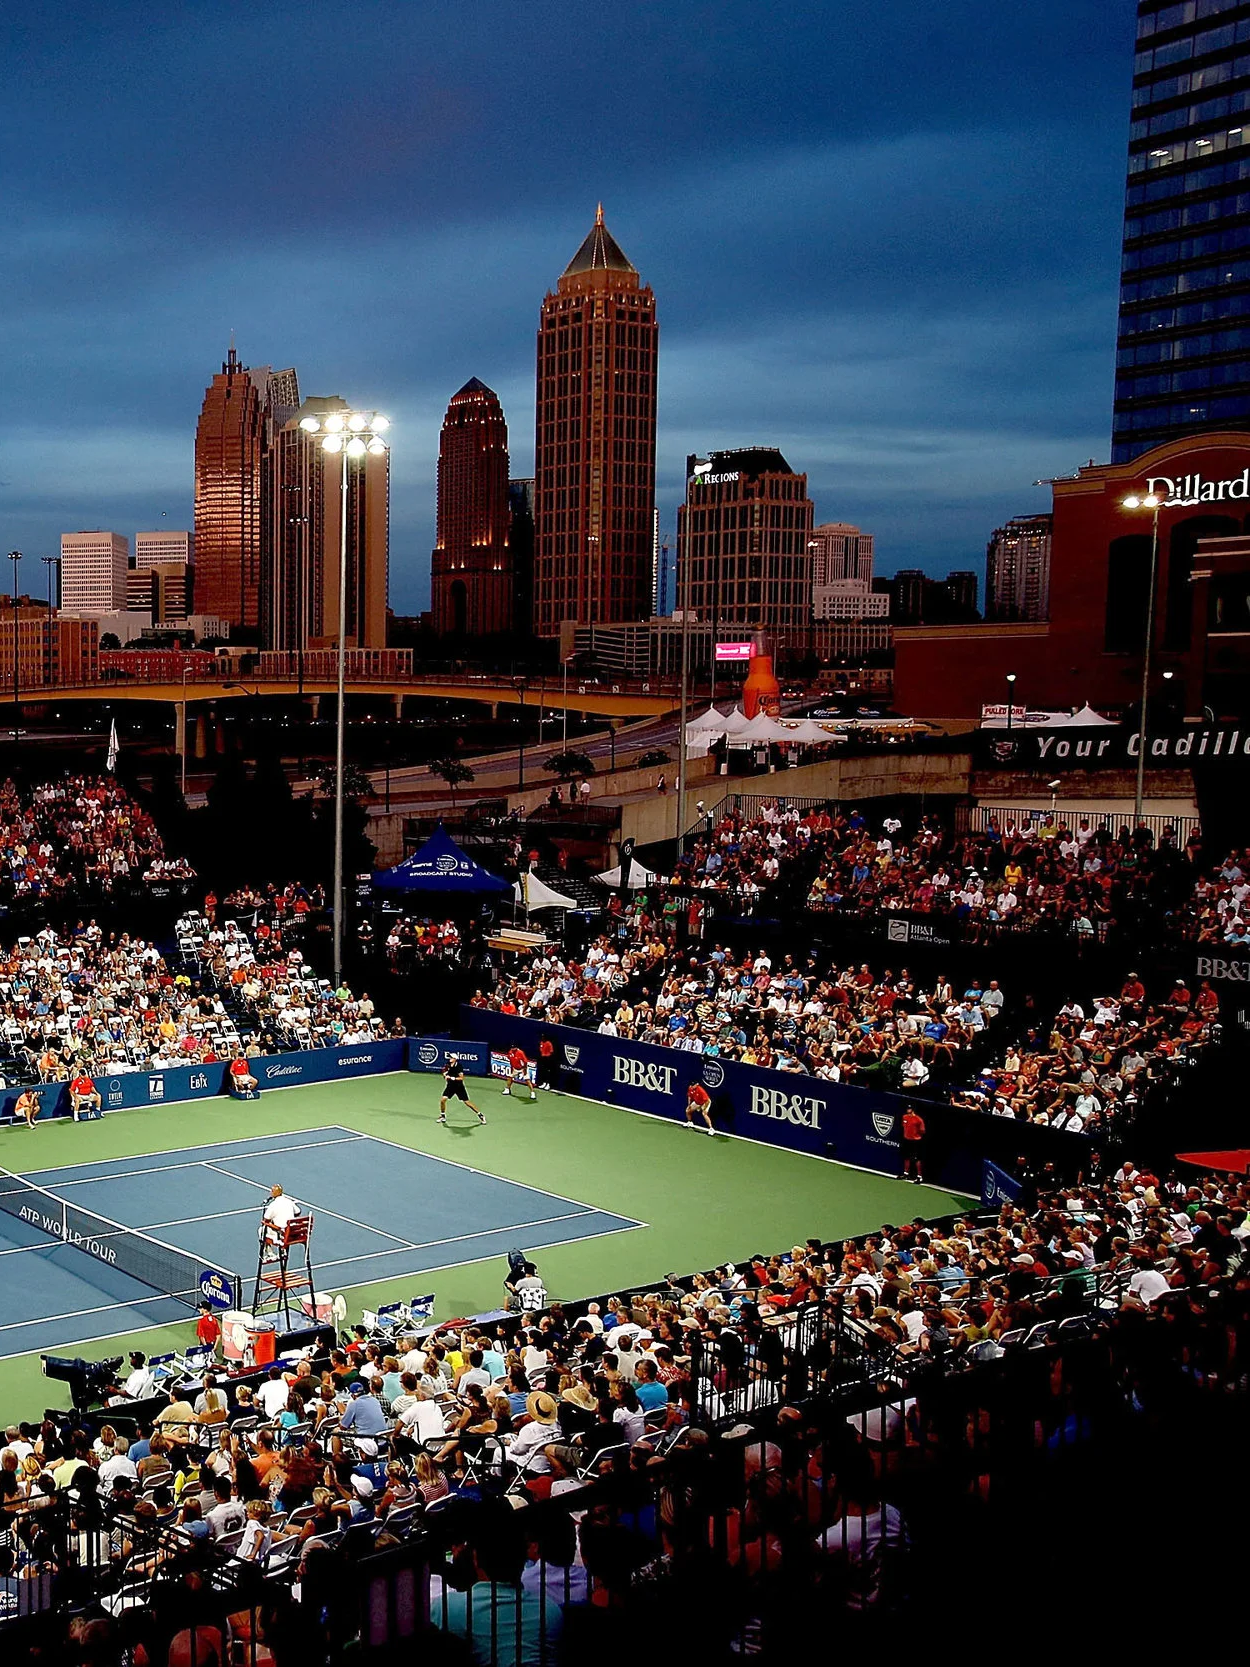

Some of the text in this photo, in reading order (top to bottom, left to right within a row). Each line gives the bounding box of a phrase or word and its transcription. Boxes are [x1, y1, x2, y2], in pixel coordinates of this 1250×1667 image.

[1146, 468, 1250, 501] Dillard
[1037, 736, 1111, 758] Your
[911, 924, 934, 935] BB&T
[266, 1064, 303, 1079] Cadillac
[338, 1055, 372, 1066] esurance
[612, 1055, 678, 1095] BB&T
[749, 1084, 826, 1130] BB&T
[865, 1135, 900, 1148] SOUTHERN
[18, 1205, 117, 1264] ATP WOLD TOUR
[202, 1280, 231, 1304] Corona
